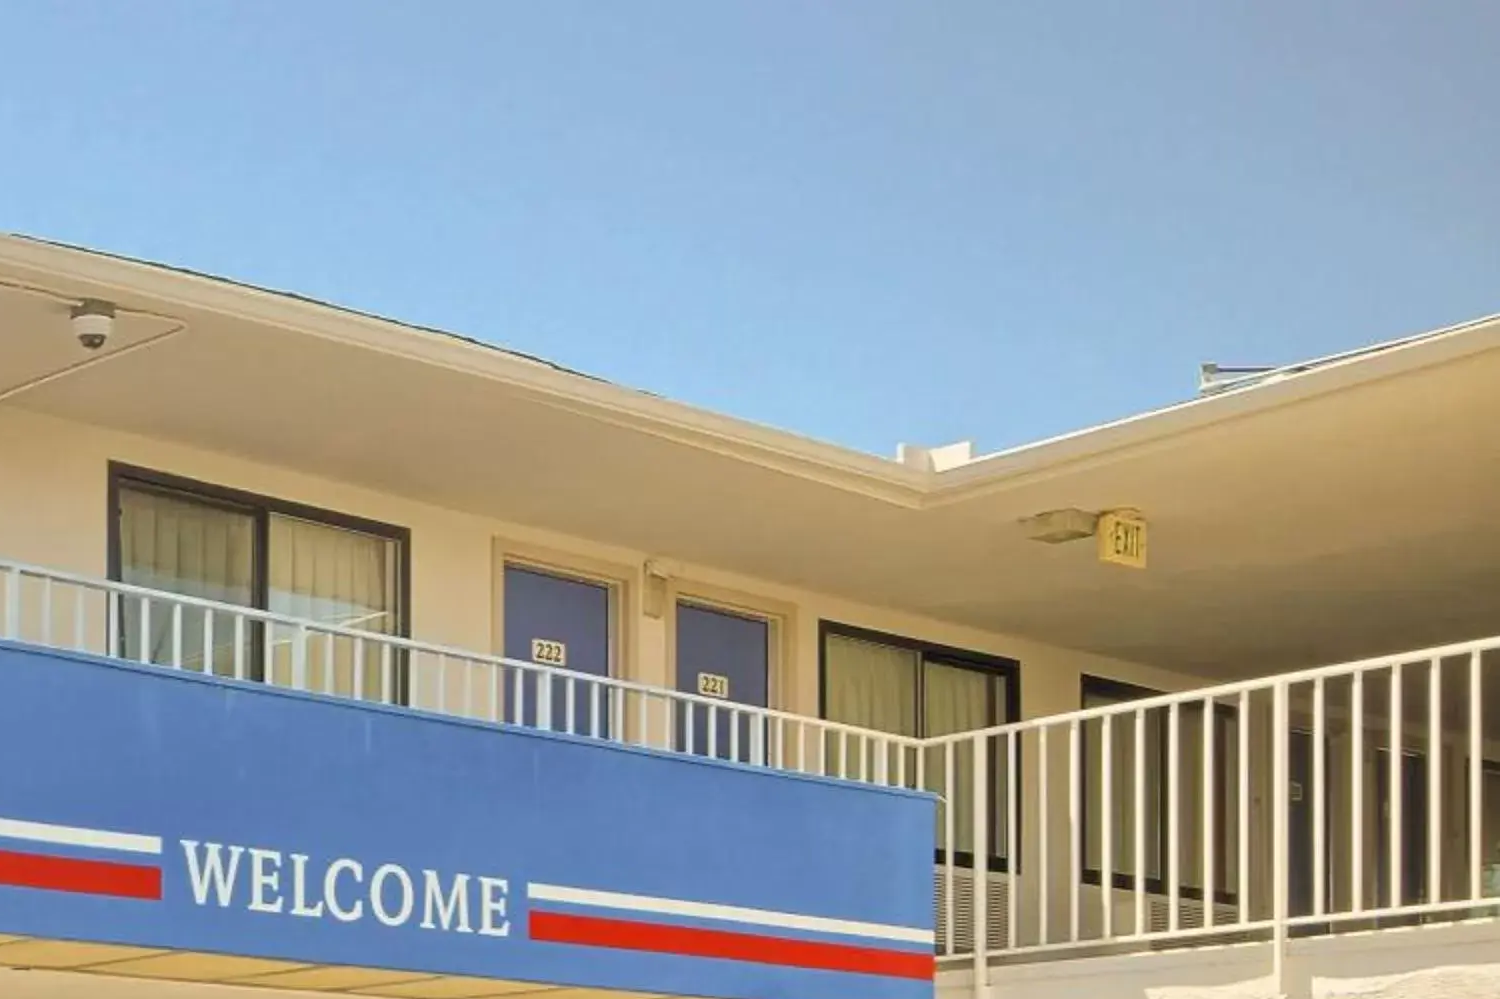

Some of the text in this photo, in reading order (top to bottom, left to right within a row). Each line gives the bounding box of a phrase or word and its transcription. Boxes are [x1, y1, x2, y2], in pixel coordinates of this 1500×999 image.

[1114, 520, 1141, 560] EXIT
[535, 642, 562, 662] 222
[701, 677, 724, 694] 221
[178, 839, 512, 938] WELCOME
